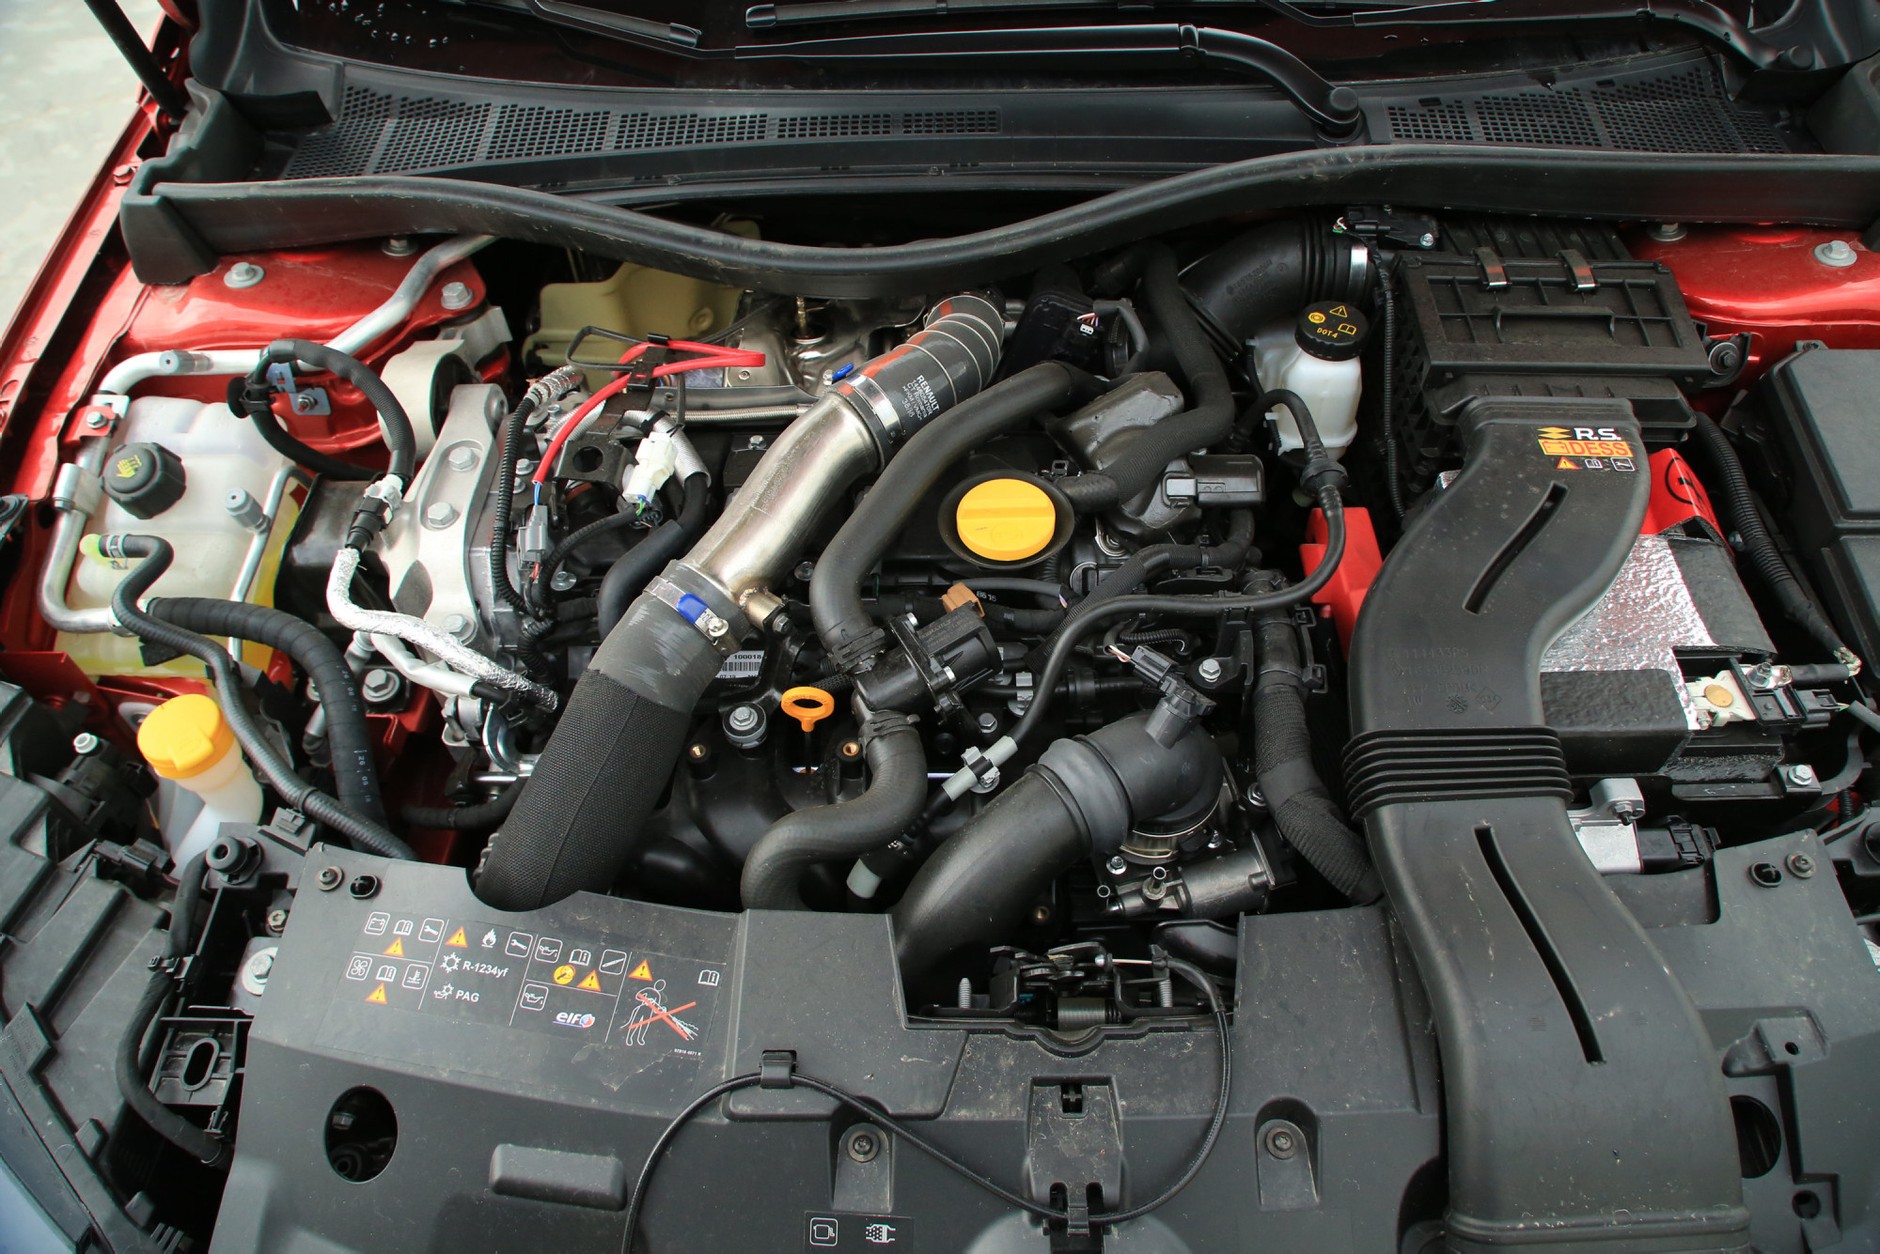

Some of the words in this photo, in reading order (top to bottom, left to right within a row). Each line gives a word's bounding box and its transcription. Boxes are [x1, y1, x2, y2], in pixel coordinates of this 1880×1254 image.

[1317, 327, 1332, 336] DOT
[916, 374, 940, 411] RENAULT
[1574, 428, 1622, 440] R.S.
[1569, 442, 1628, 455] DESS
[462, 960, 508, 978] R-1234yf
[455, 990, 480, 1003] PAG
